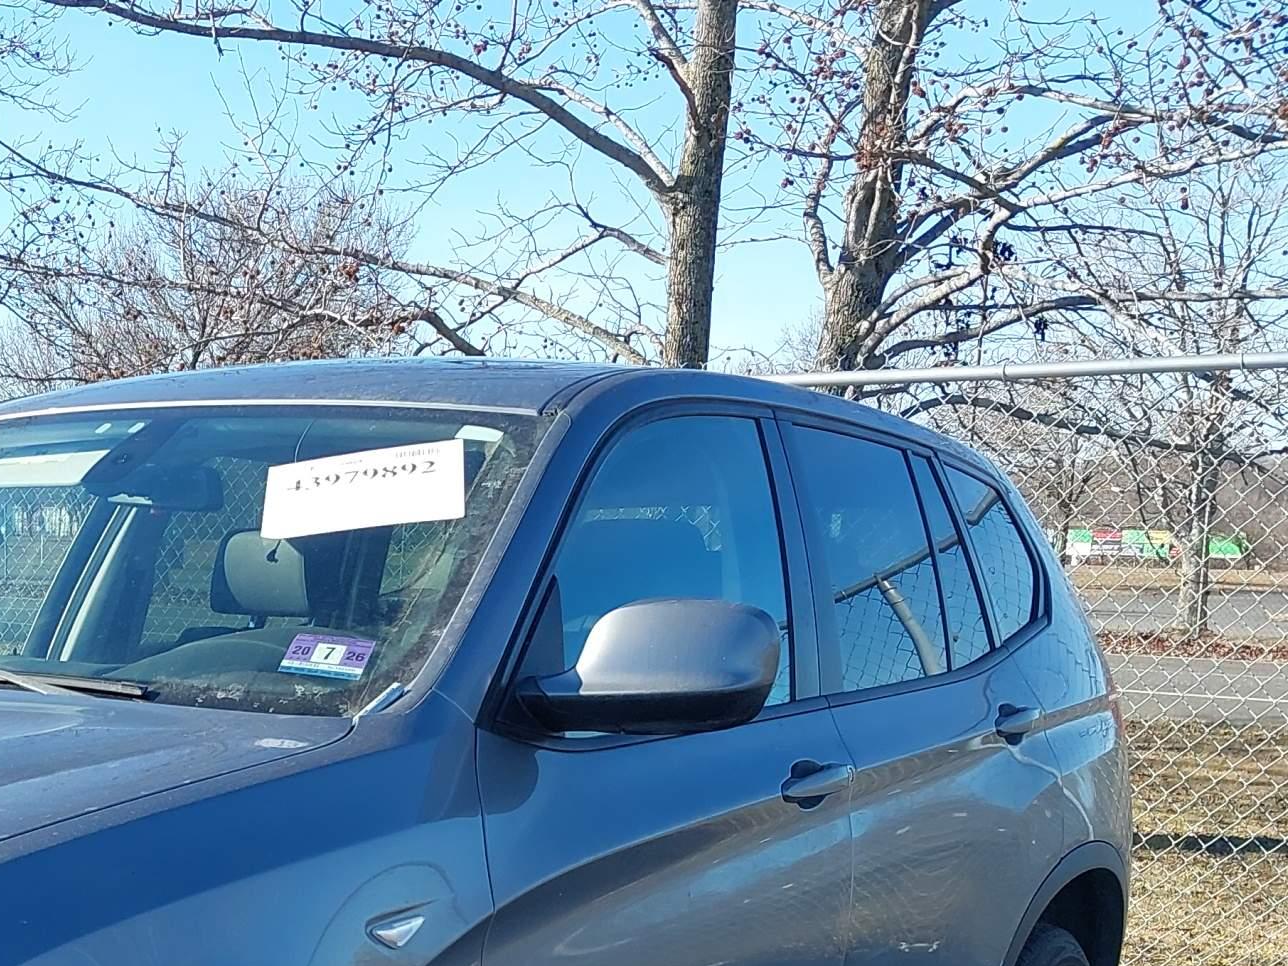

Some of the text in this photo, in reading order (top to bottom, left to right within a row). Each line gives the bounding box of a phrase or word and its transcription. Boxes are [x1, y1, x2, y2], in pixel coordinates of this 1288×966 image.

[286, 460, 437, 492] 43979892
[292, 645, 366, 662] 20 7 26
